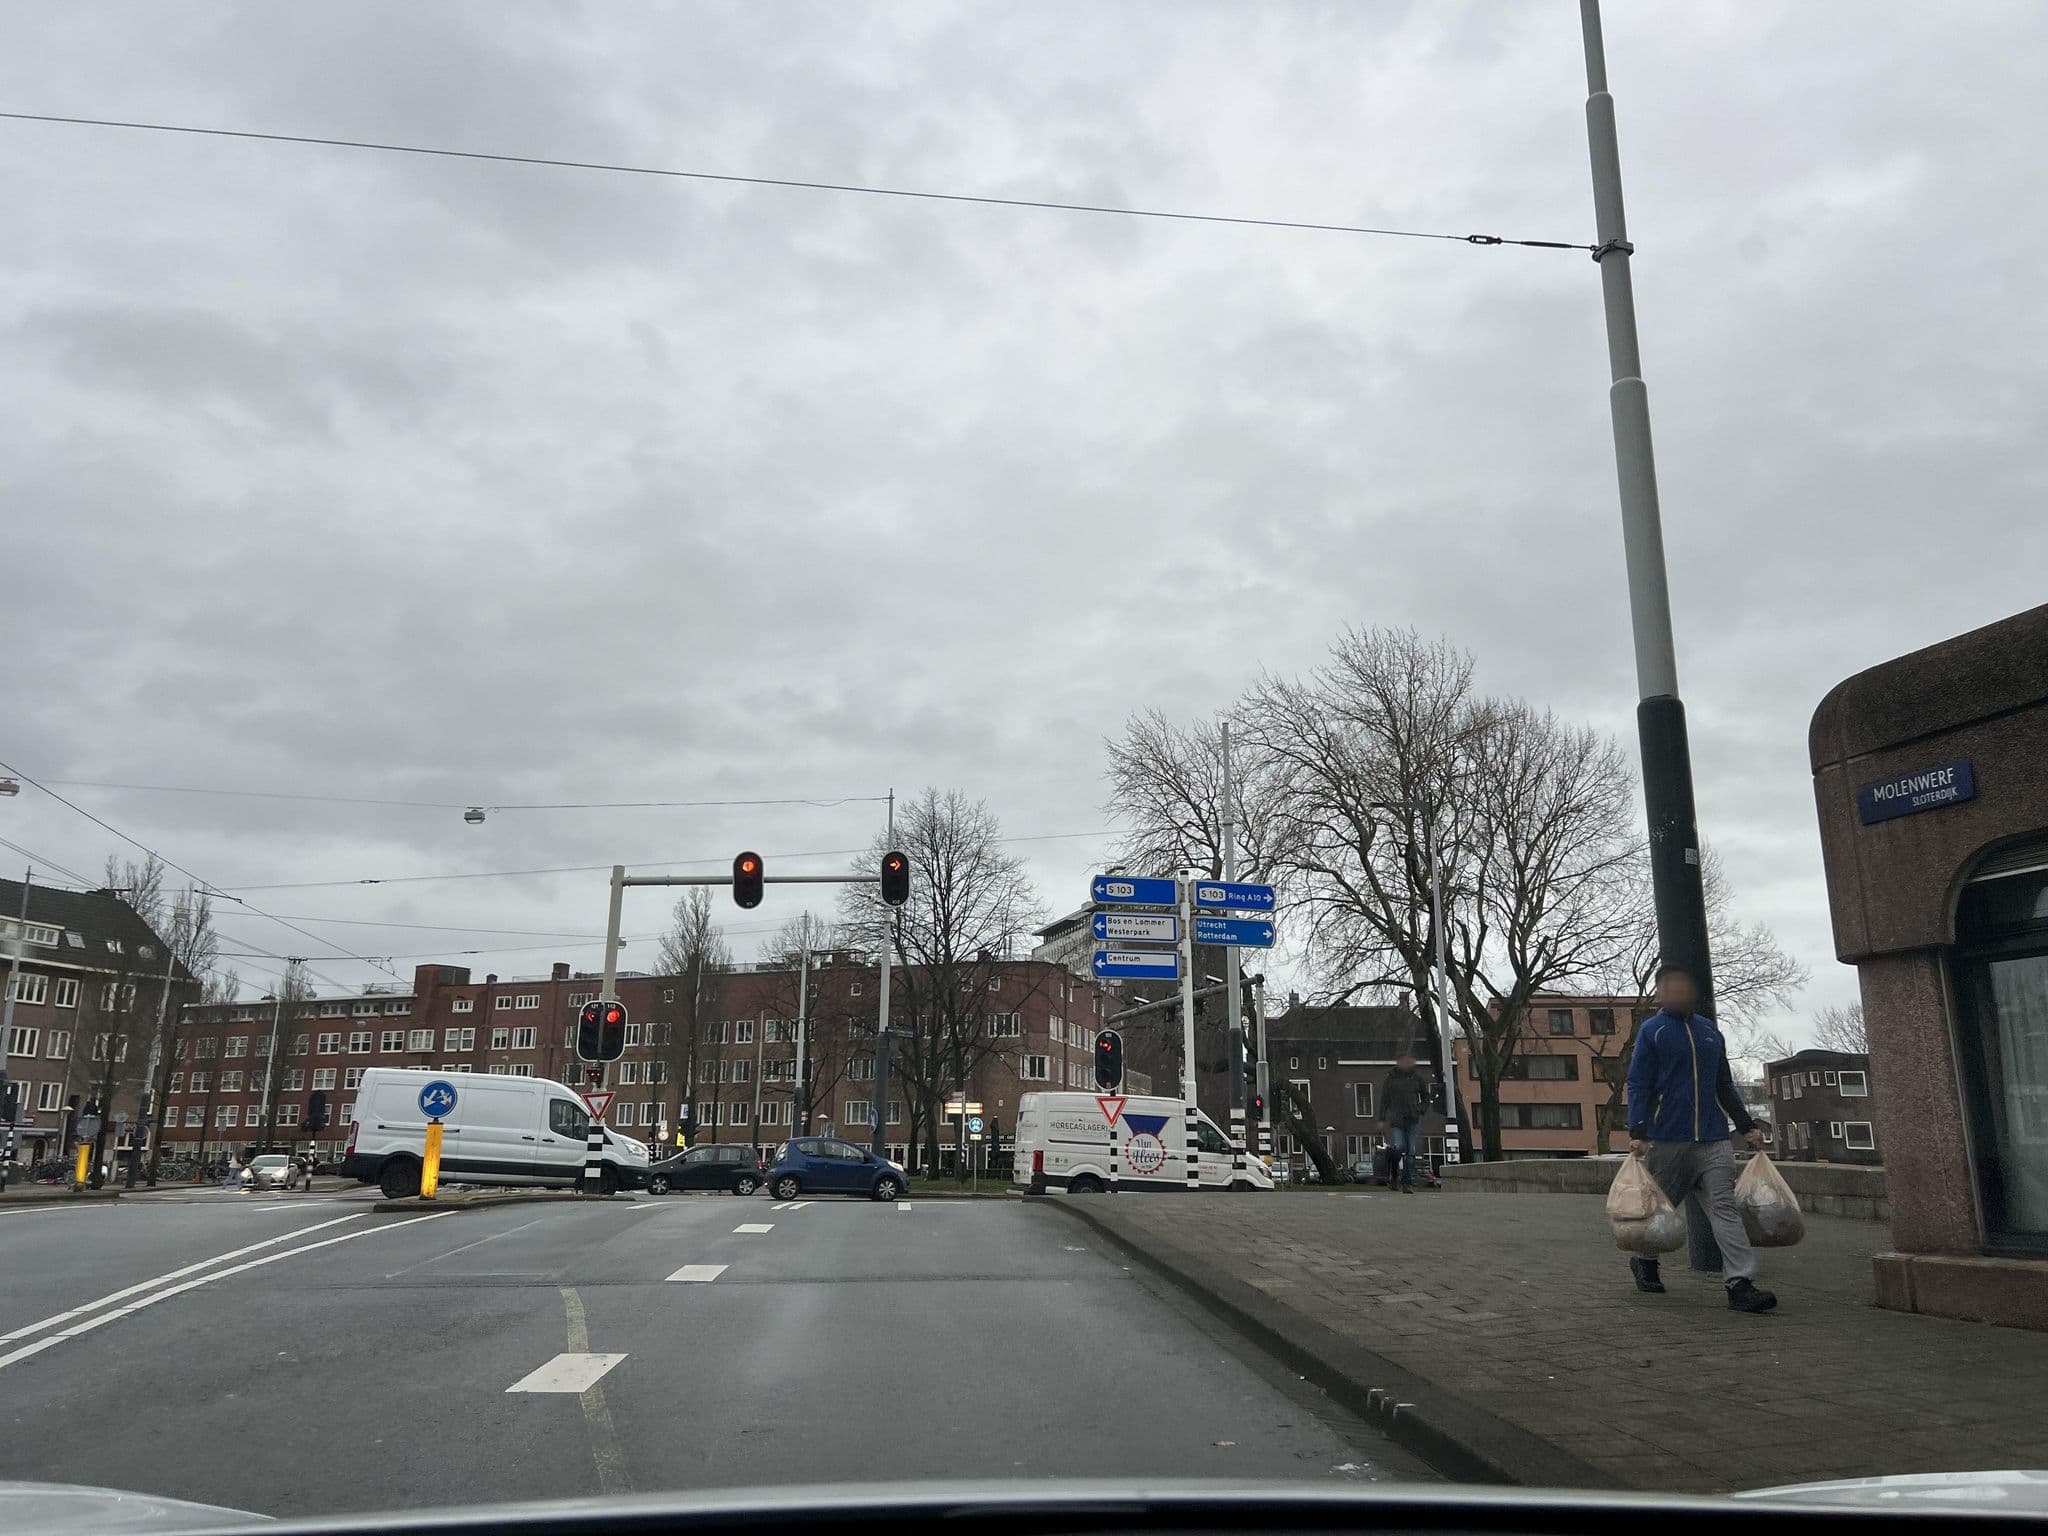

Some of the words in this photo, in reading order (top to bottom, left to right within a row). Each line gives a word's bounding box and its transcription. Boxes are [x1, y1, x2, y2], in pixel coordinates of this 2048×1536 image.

[1874, 767, 1954, 802] MOLENWERF
[1912, 786, 1958, 807] SLOTERDIJK
[1117, 886, 1133, 895] 103
[1201, 889, 1207, 897] S
[1209, 890, 1224, 899] 103
[1228, 892, 1245, 902] Ring
[1108, 917, 1121, 925] Bos
[1135, 918, 1165, 926] Lommer
[1197, 921, 1226, 930] Utrecht
[1108, 927, 1151, 936] Westerpark
[1198, 932, 1237, 941] Rotterdam
[1108, 954, 1141, 962] Centrum
